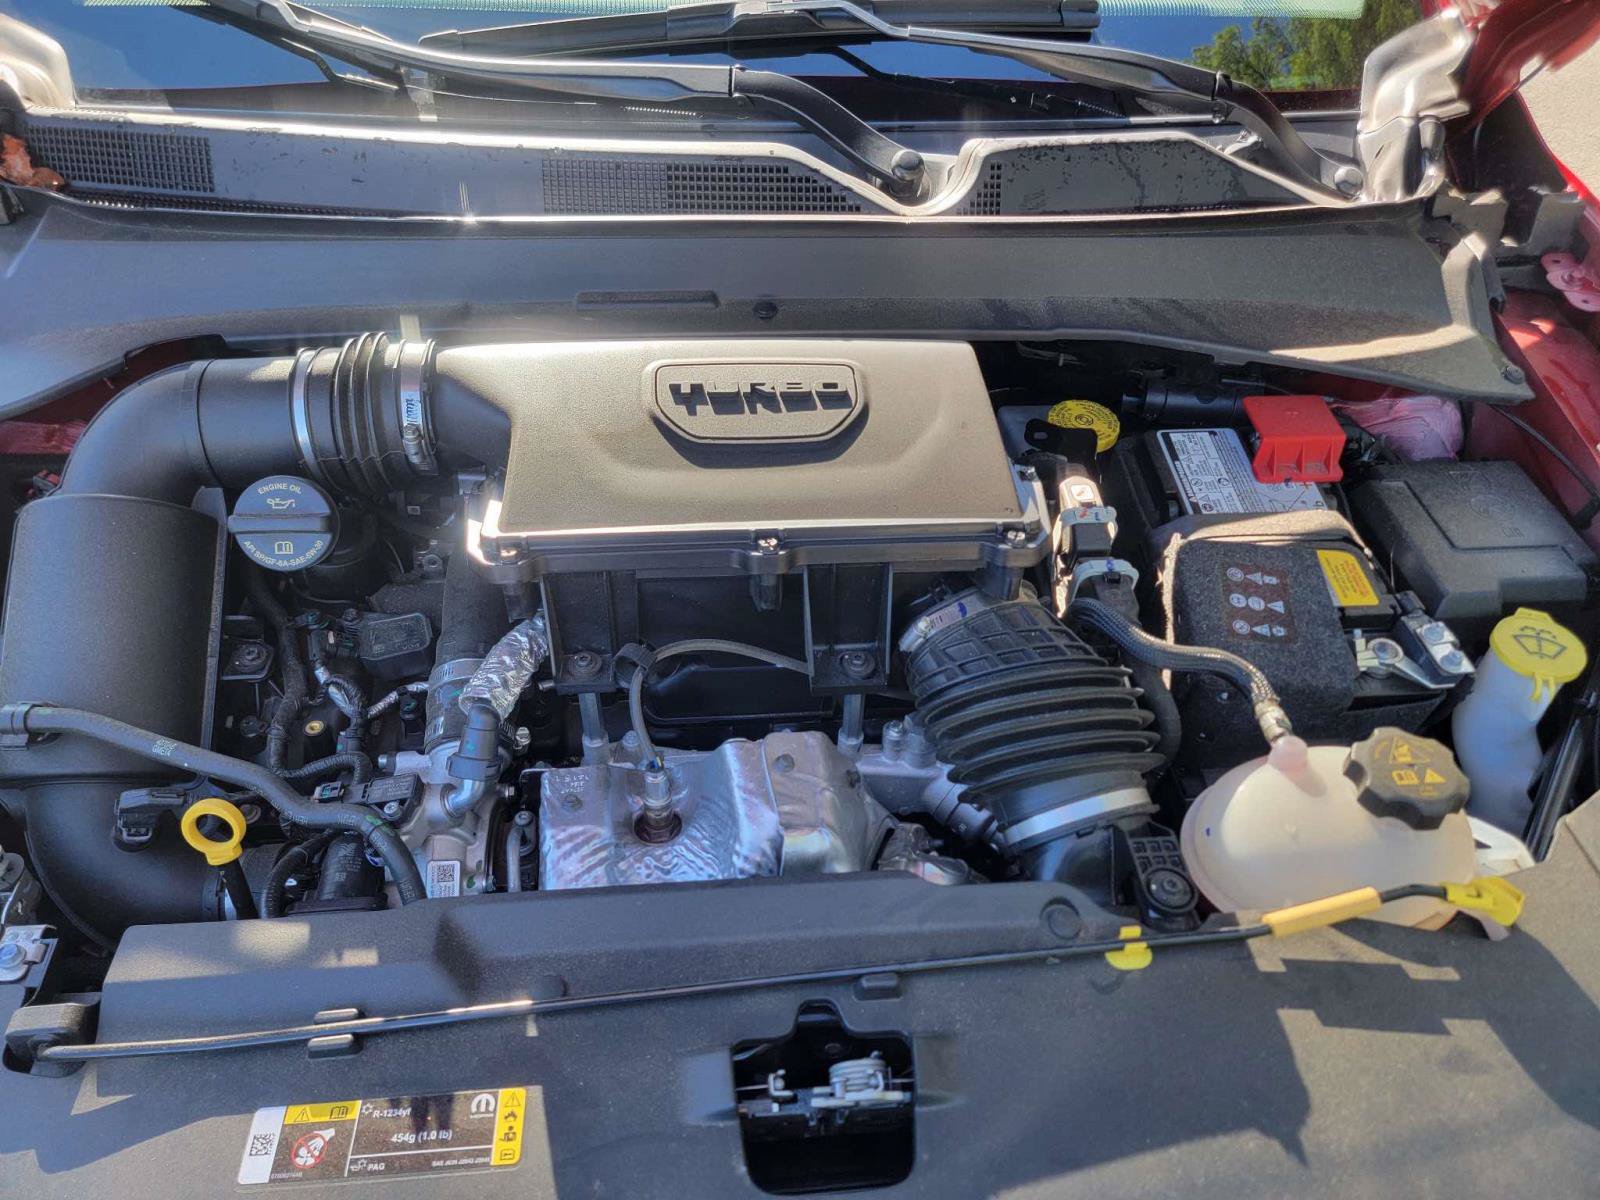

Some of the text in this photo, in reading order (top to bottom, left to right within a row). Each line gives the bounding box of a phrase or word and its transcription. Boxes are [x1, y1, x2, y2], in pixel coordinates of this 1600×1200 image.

[667, 380, 853, 417] TURBO
[258, 482, 302, 495] ENGINE OIL
[373, 1107, 412, 1119] R-1234yf
[390, 1128, 453, 1144] 454g (1.0 lb)
